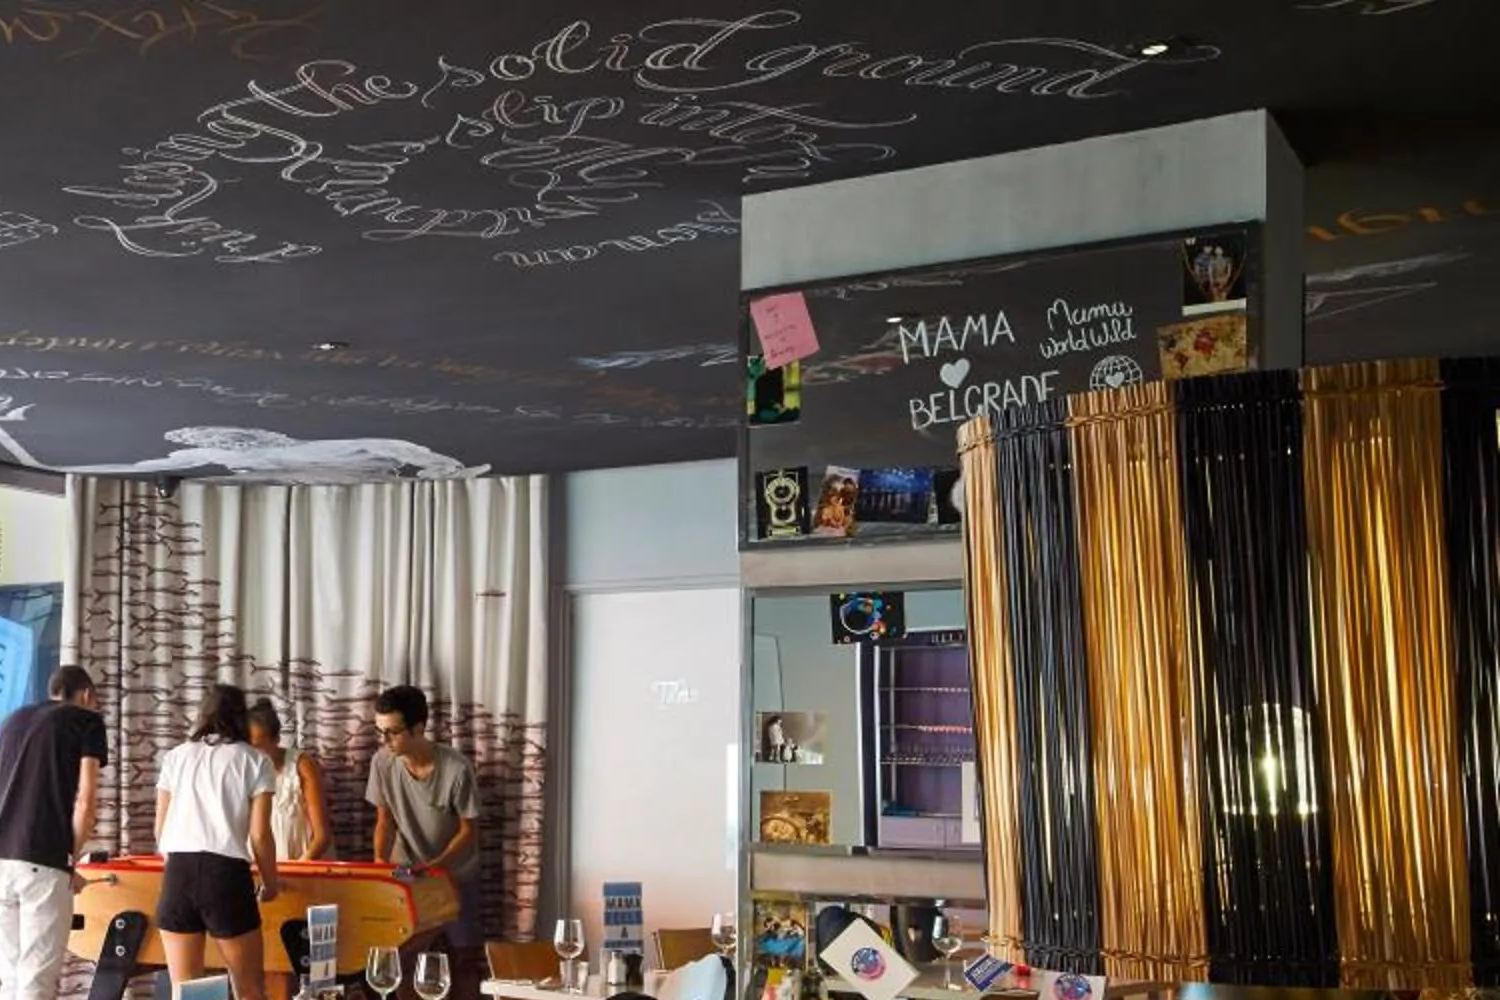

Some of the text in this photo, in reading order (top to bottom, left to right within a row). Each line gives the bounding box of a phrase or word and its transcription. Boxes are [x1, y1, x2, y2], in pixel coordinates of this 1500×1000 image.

[420, 9, 801, 107] solid
[637, 36, 1221, 98] ground
[198, 58, 418, 122] the
[444, 89, 626, 148] slip
[898, 311, 1016, 365] MAMA
[909, 371, 1060, 430] BELGRADE
